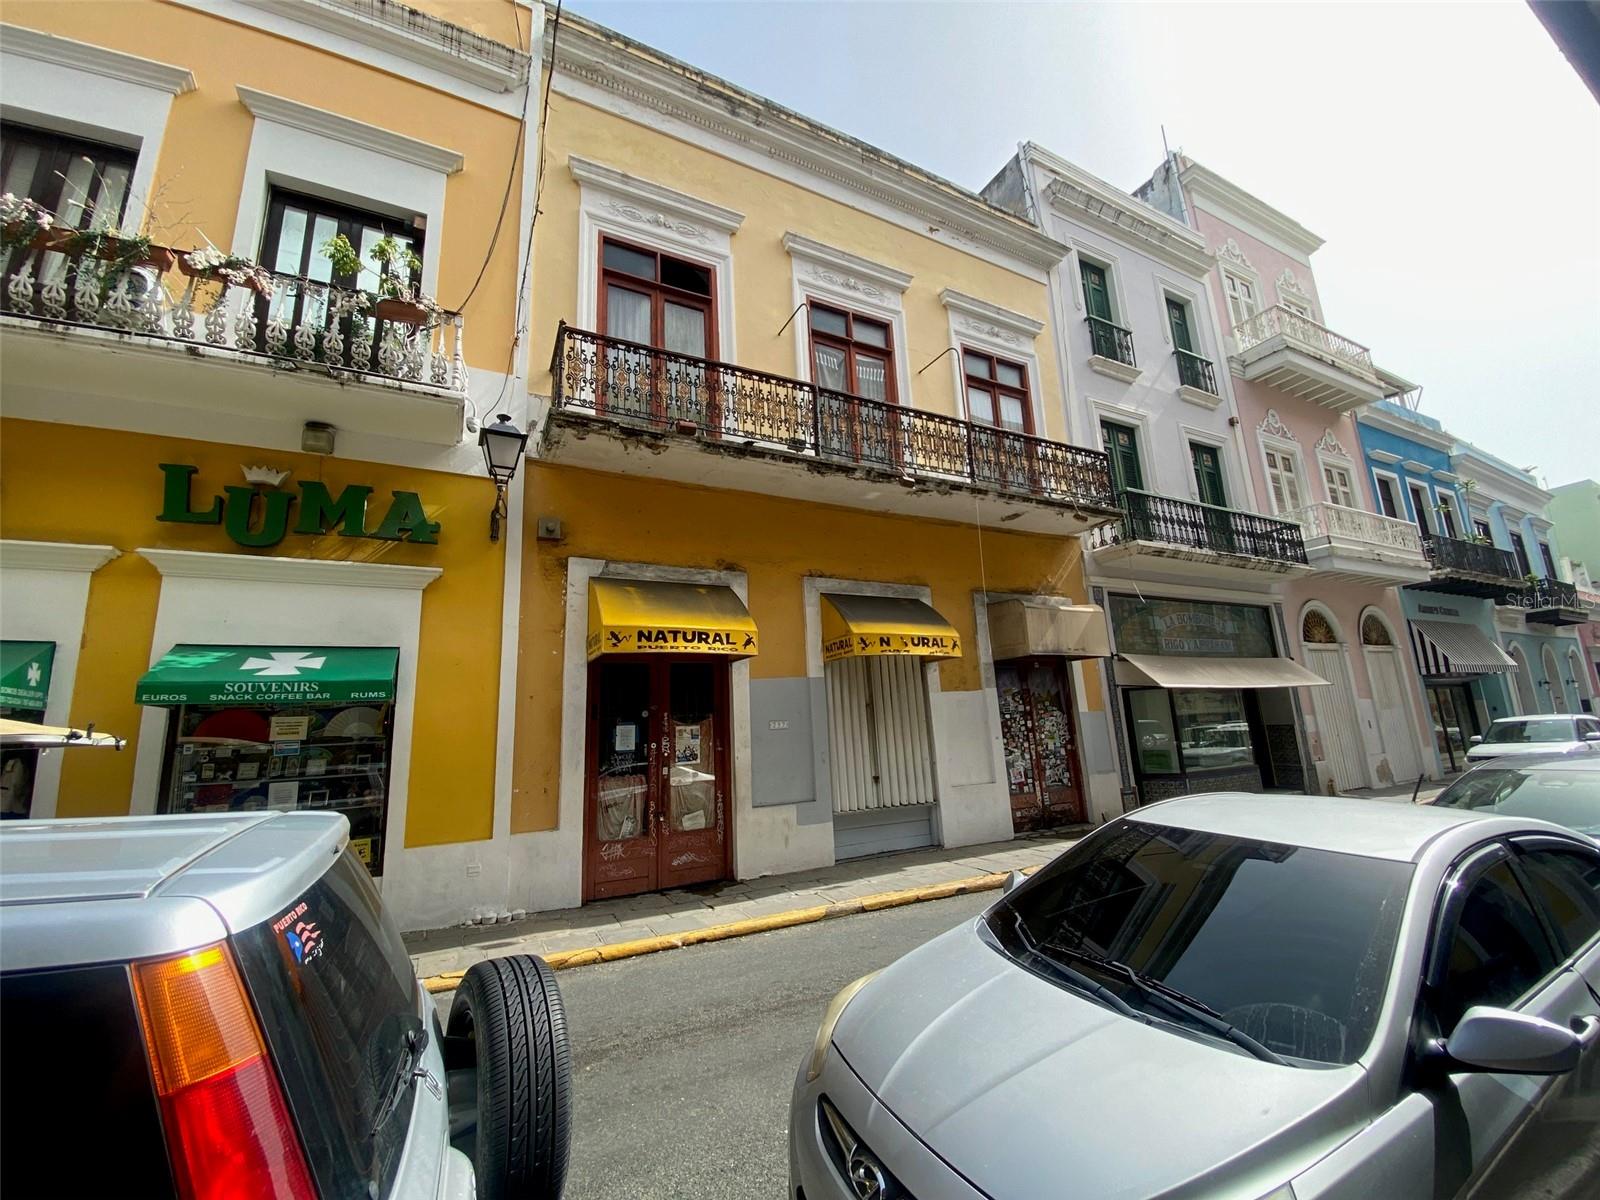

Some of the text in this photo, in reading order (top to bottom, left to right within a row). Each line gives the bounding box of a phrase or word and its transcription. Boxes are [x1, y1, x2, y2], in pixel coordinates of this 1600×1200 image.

[156, 463, 441, 547] LUMA
[637, 630, 737, 645] NATURAL
[880, 636, 948, 649] NURAL
[825, 637, 854, 655] NATURAL
[224, 682, 320, 693] SOUVENIRS
[273, 910, 298, 934] PUERTO
